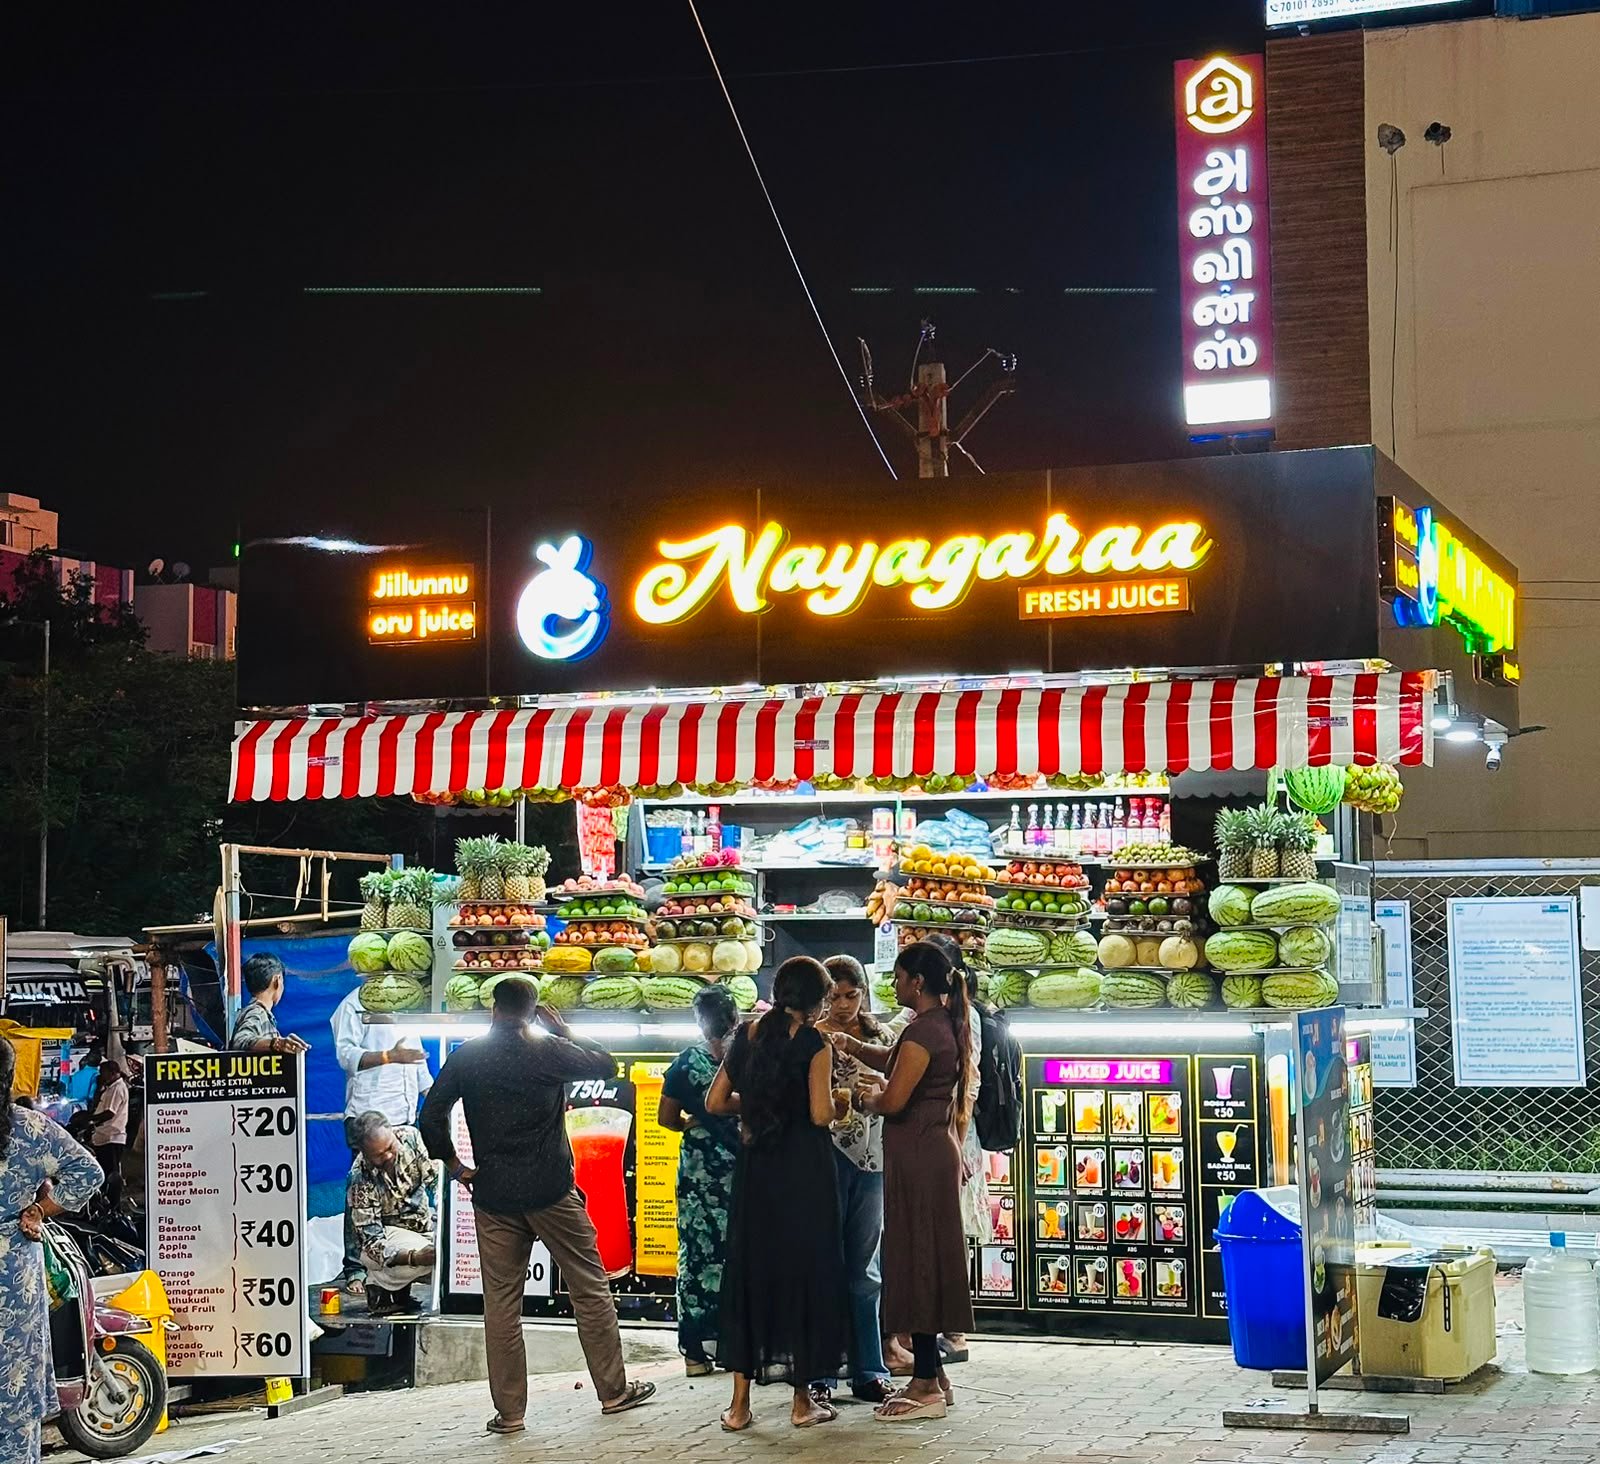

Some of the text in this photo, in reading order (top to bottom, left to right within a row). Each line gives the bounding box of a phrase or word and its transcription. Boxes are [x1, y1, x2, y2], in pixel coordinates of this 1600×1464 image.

[1188, 148, 1258, 372] அஸ்வின்ஸ்
[633, 513, 1214, 624] Nayagaraa
[374, 572, 468, 598] Jillunnu
[1025, 584, 1180, 614] FRESH JUICE
[372, 606, 474, 638] oru juice
[156, 1055, 282, 1080] FRESH JUICE
[1059, 1064, 1160, 1080] MIXED JUICE
[157, 1090, 205, 1099] WITHOUT
[228, 1088, 248, 1096] 5RS
[252, 1086, 286, 1095] EXTRA
[182, 1080, 210, 1088] PARCEL
[237, 1106, 295, 1137] ₹20
[1214, 1108, 1234, 1118] ₹50
[158, 1170, 207, 1179] Pineapple
[240, 1164, 293, 1193] ₹30
[1217, 1171, 1236, 1180] ₹50
[158, 1216, 174, 1225] Fig
[241, 1220, 294, 1248] ₹40
[158, 1243, 187, 1251] Apple
[165, 1287, 225, 1296] omegranate
[243, 1278, 295, 1306] ₹50
[180, 1324, 214, 1332] wberry
[241, 1332, 292, 1357] ₹60
